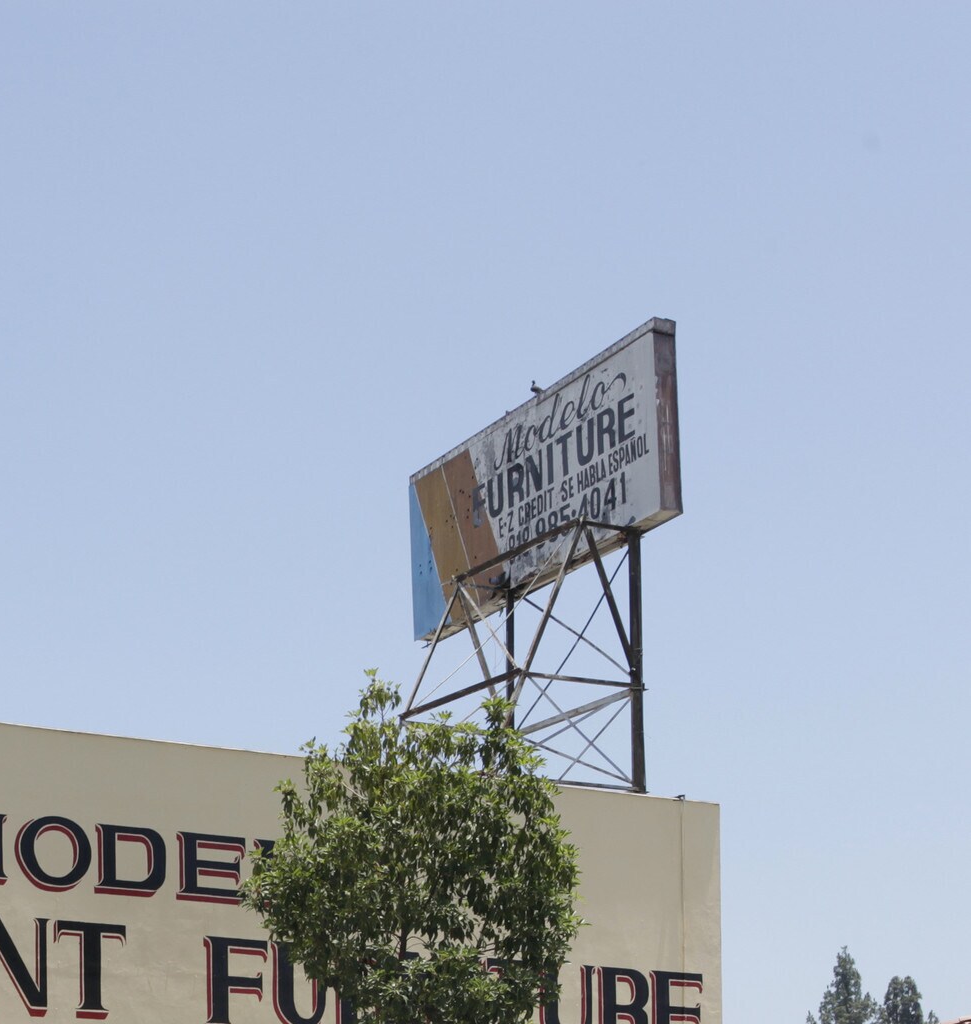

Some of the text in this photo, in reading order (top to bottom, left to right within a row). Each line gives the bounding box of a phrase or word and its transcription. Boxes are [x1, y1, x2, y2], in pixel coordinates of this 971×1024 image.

[472, 393, 636, 528] FURNITURE
[494, 372, 626, 471] Modelo
[518, 487, 555, 529] CREDIT
[561, 477, 574, 502] SE
[577, 459, 606, 494] HABLA
[608, 433, 649, 476] ESPAÑOL
